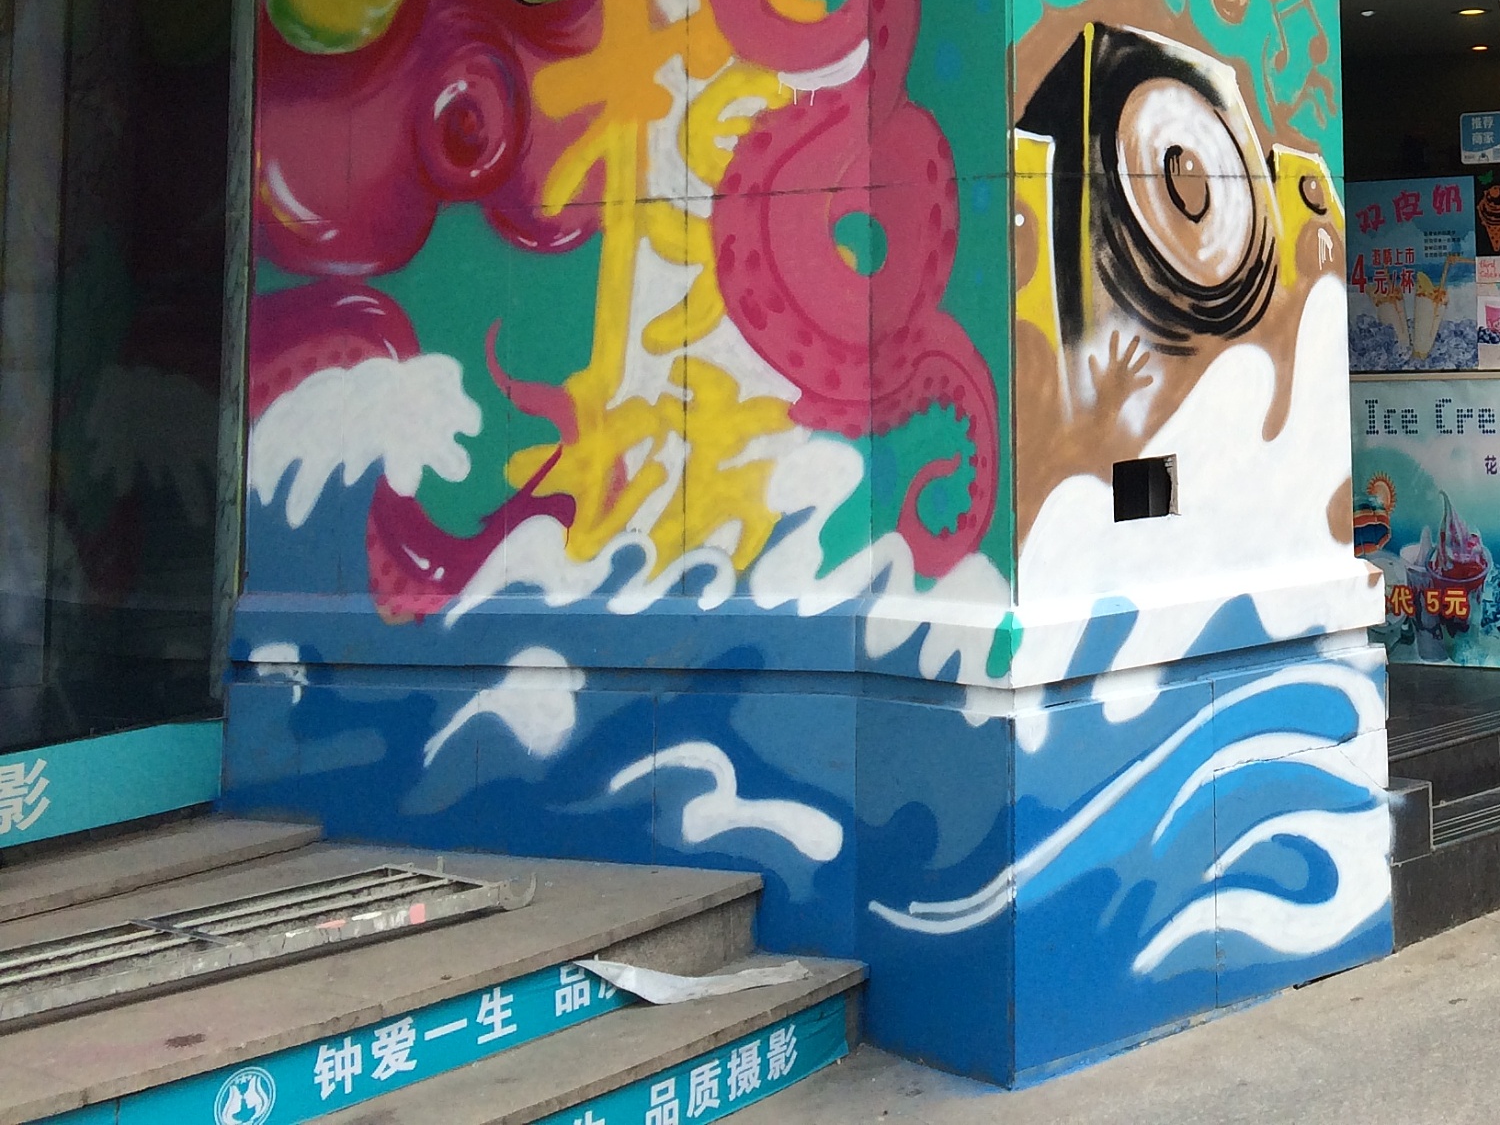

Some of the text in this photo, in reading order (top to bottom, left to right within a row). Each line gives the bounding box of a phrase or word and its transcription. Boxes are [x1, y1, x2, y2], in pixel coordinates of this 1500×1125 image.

[1355, 184, 1463, 235] 双皮奶
[1351, 254, 1368, 296] 4
[1364, 398, 1418, 435] Ice
[1425, 588, 1469, 617] 5元
[313, 961, 620, 1101] 钟爱一生 品
[645, 1024, 798, 1125] 品质摄影
